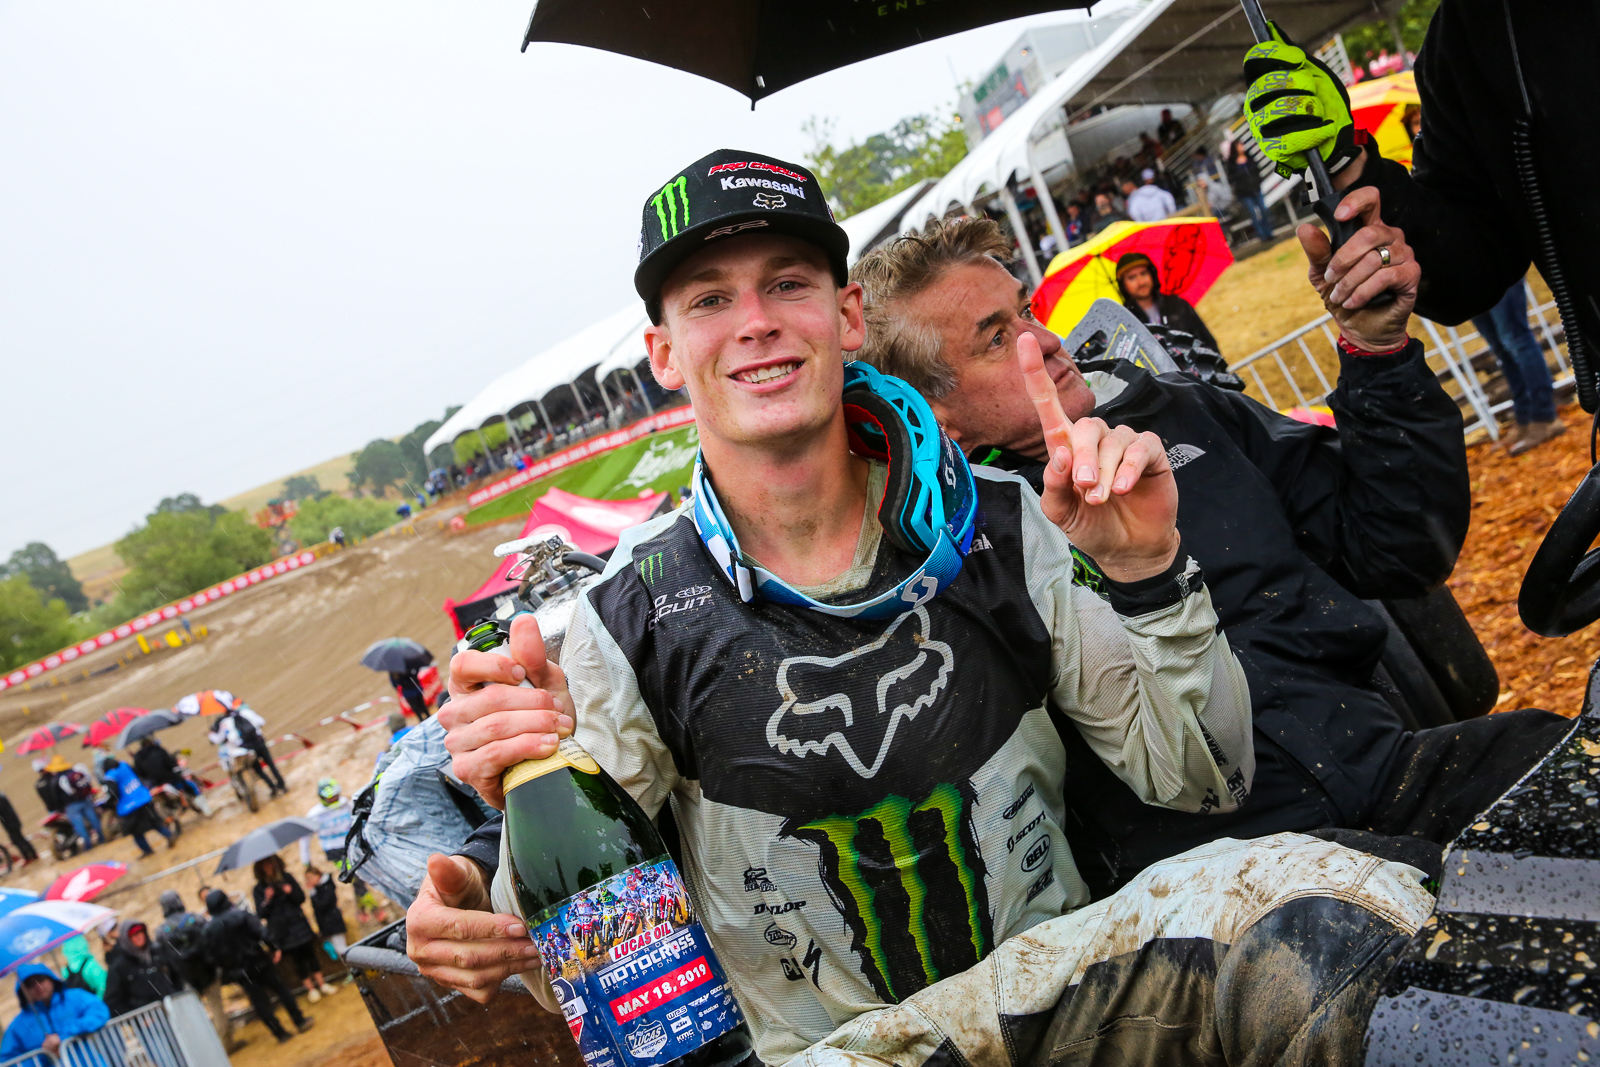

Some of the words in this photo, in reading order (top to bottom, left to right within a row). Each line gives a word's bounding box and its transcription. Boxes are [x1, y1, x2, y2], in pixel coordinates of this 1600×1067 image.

[707, 161, 748, 177] PRO
[748, 161, 807, 183] CIRCUIT
[720, 175, 806, 200] Kawasaki
[1014, 810, 1047, 845] SCOTT
[1025, 839, 1049, 869] BELL
[614, 931, 652, 960] LUCAS
[653, 922, 671, 940] OIL
[633, 940, 664, 960] PRO
[598, 932, 696, 990] MOTOCROSS
[604, 944, 699, 995] CHAMPIONHIP
[616, 990, 650, 1017] MAY
[652, 981, 678, 1000] 18,
[676, 963, 707, 988] 2019
[633, 1026, 663, 1048] LUCAS
